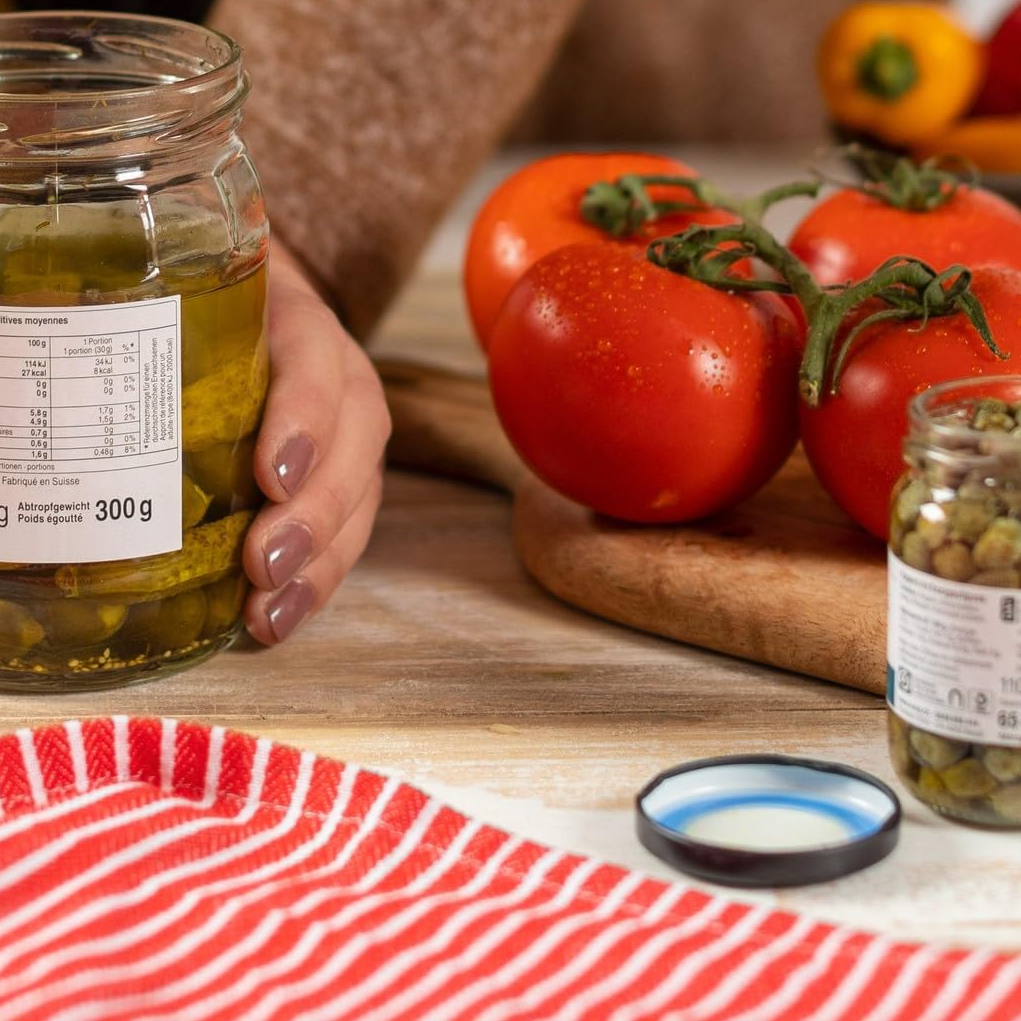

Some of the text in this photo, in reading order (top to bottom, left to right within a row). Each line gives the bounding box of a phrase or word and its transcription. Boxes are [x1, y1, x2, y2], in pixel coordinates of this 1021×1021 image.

[25, 317, 68, 326] moyennes
[89, 337, 112, 345] Portion
[69, 347, 92, 356] portion
[100, 366, 112, 374] kcal
[2, 476, 37, 487] Fabriqué
[40, 478, 50, 486] en
[52, 477, 80, 486] Suisse
[17, 501, 90, 514] Abtropfgewicht
[95, 497, 152, 522] 300 g
[17, 513, 83, 525] Poids égoutté
